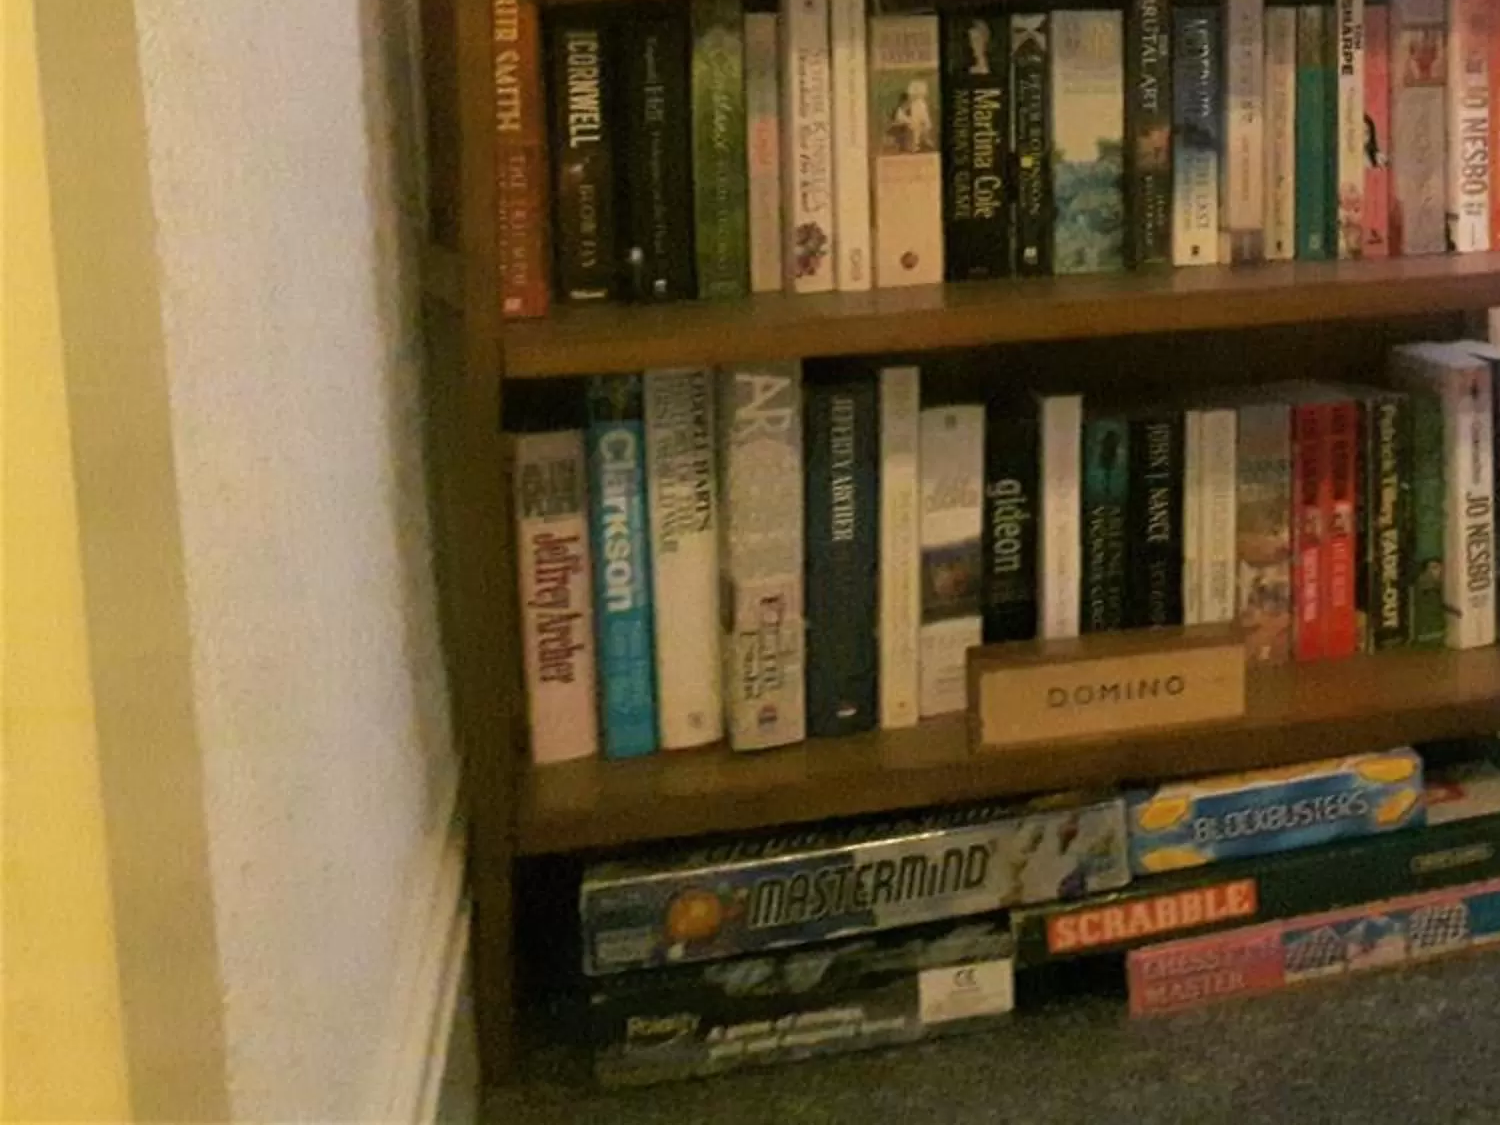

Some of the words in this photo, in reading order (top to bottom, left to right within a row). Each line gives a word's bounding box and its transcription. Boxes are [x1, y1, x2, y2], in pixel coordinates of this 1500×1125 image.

[494, 50, 521, 132] SMITH
[567, 40, 601, 149] CORNWELL
[1141, 73, 1159, 112] ART
[973, 87, 1000, 169] Martina
[973, 174, 1002, 219] Cole
[1379, 402, 1398, 472] Patrick
[596, 428, 638, 613] Clarkson
[831, 473, 856, 542] ARCHER
[986, 477, 1031, 574] gideon
[1466, 490, 1490, 519] JO
[527, 531, 583, 610] Jeffrey
[535, 612, 585, 686] Archer
[1047, 674, 1186, 709] DOMINO
[1192, 789, 1370, 844] BLOCKBUSTERS
[748, 844, 990, 928] MASTERMIND
[1053, 882, 1253, 951] SCRABBLE
